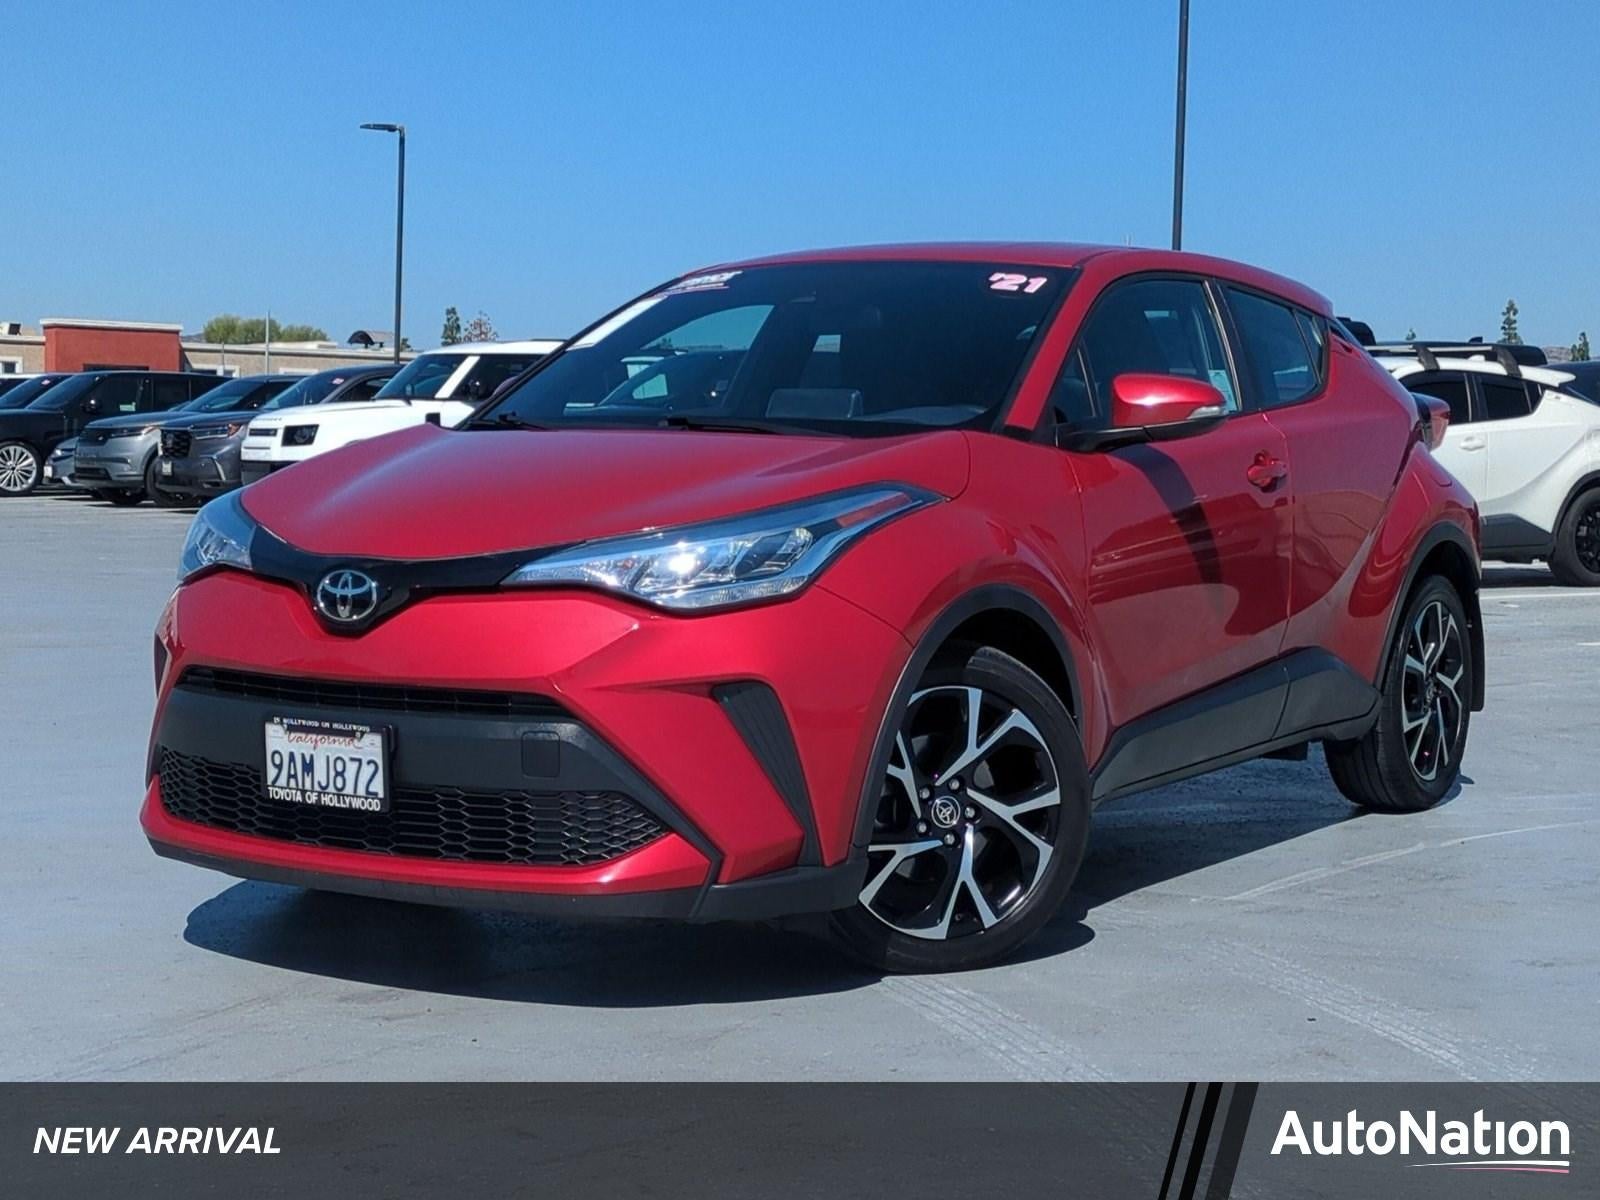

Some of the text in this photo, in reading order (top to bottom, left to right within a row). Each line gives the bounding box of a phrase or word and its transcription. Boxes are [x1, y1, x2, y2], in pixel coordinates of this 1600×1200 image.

[270, 749, 380, 797] 9AMJ872
[267, 786, 381, 811] TOYOTA OF HOLLYWOOD
